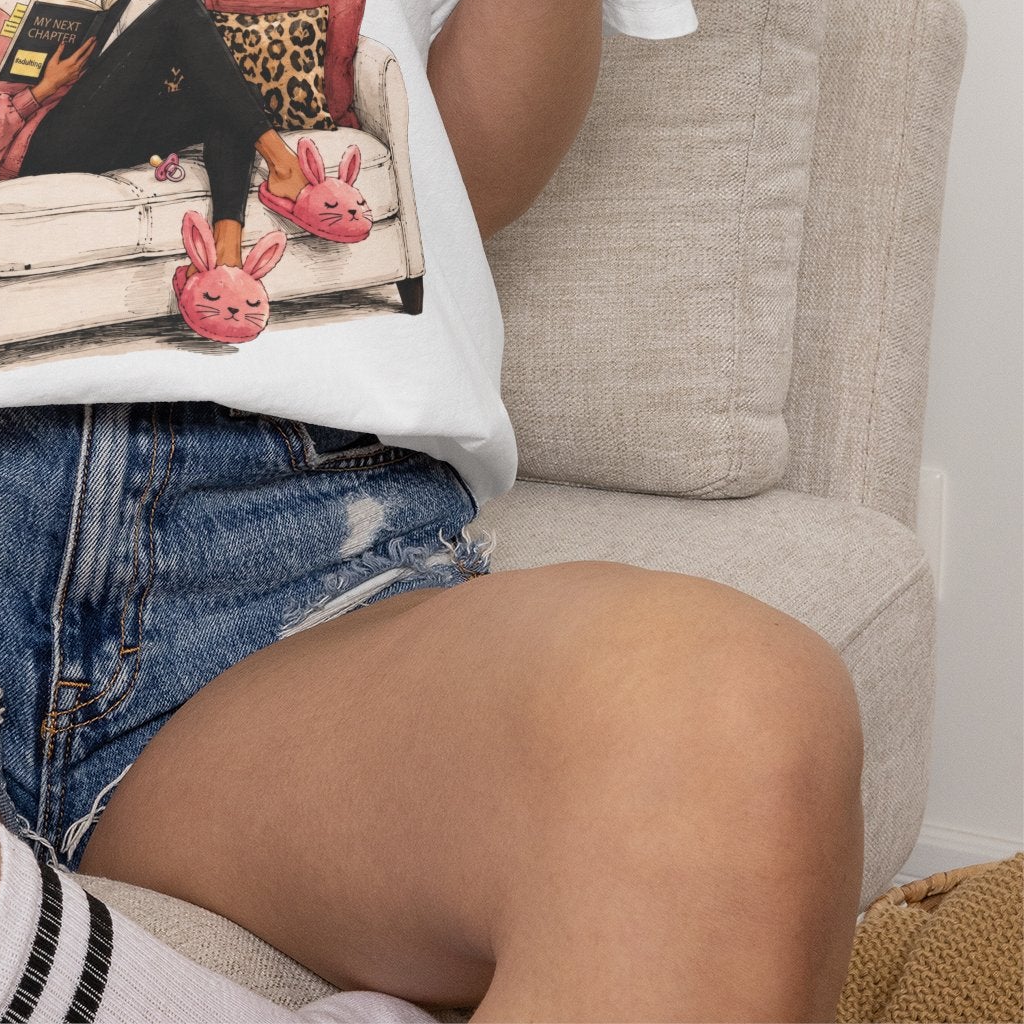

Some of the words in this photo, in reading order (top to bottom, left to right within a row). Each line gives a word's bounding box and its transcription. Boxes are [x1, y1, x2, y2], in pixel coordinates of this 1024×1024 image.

[33, 16, 51, 27] MY
[52, 20, 82, 32] NEXT
[28, 28, 77, 43] CHAPTER
